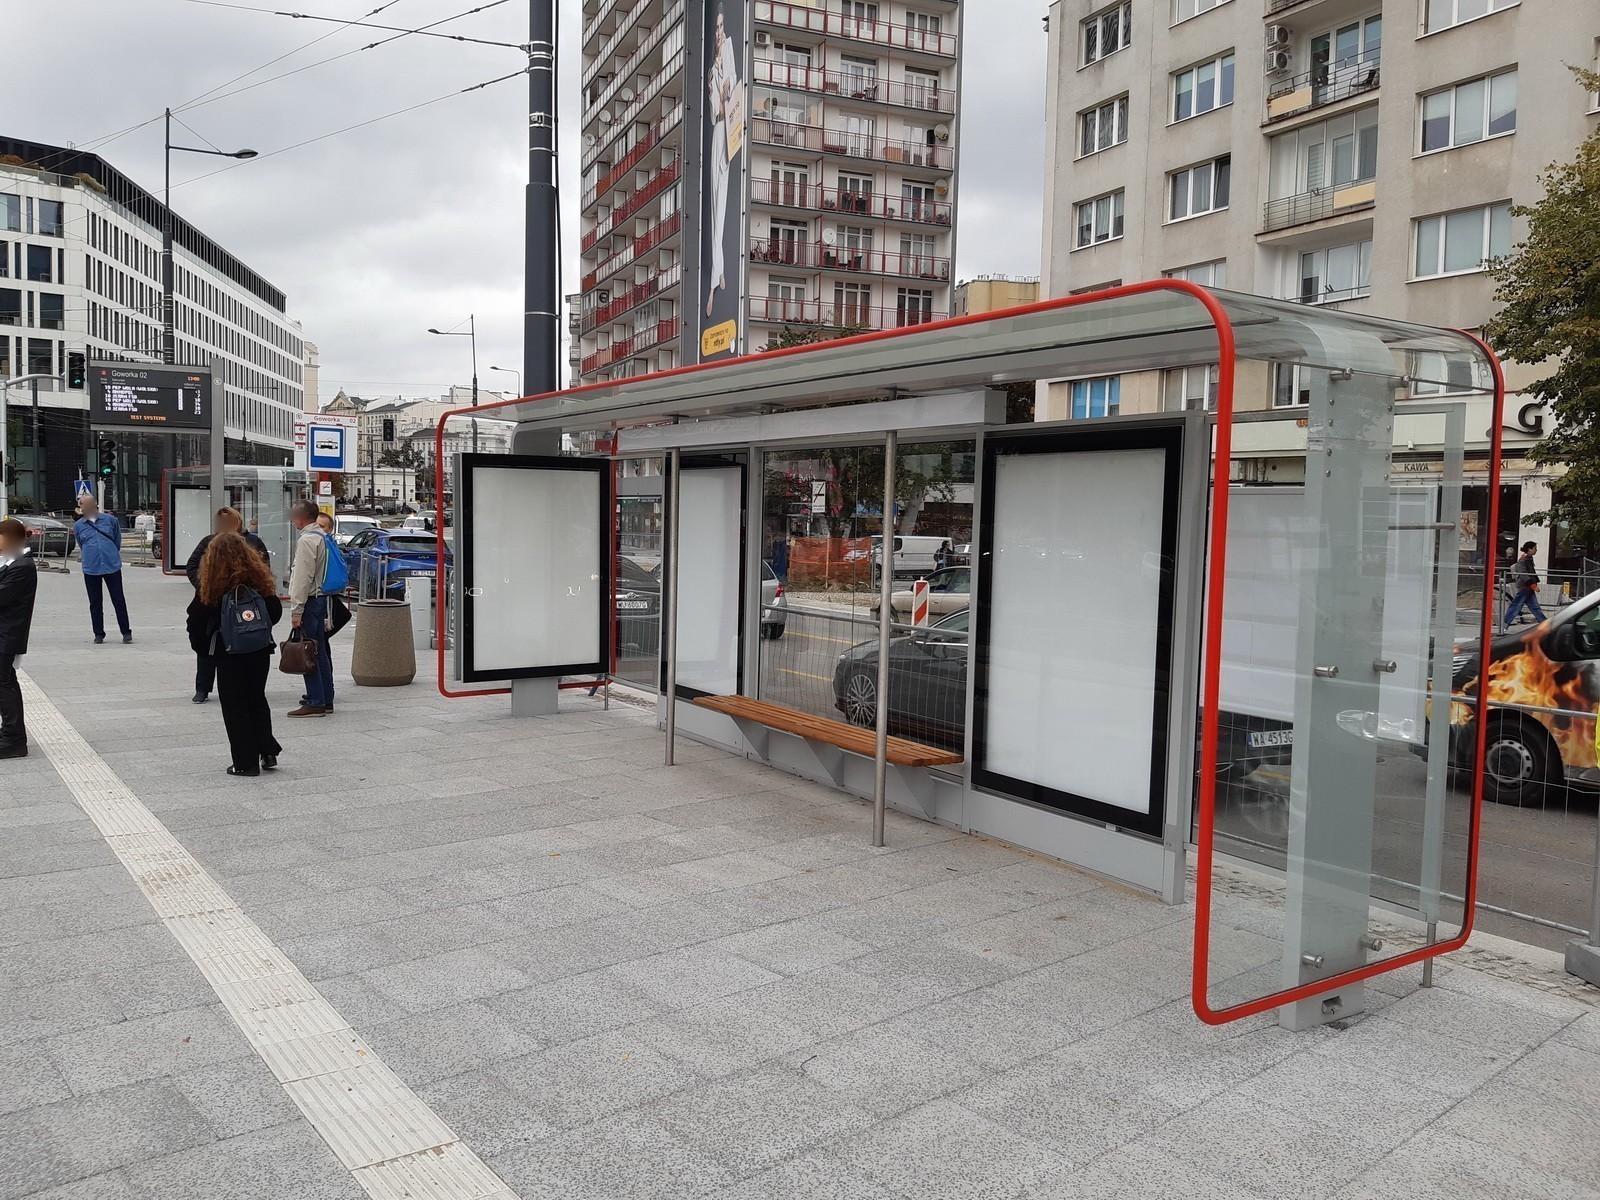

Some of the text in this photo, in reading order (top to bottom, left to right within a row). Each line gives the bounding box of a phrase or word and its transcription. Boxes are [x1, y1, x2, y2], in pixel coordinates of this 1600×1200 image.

[112, 370, 138, 378] Goworka
[1404, 463, 1429, 472] KAWA
[1484, 460, 1509, 469] SKI
[1253, 733, 1265, 745] WA
